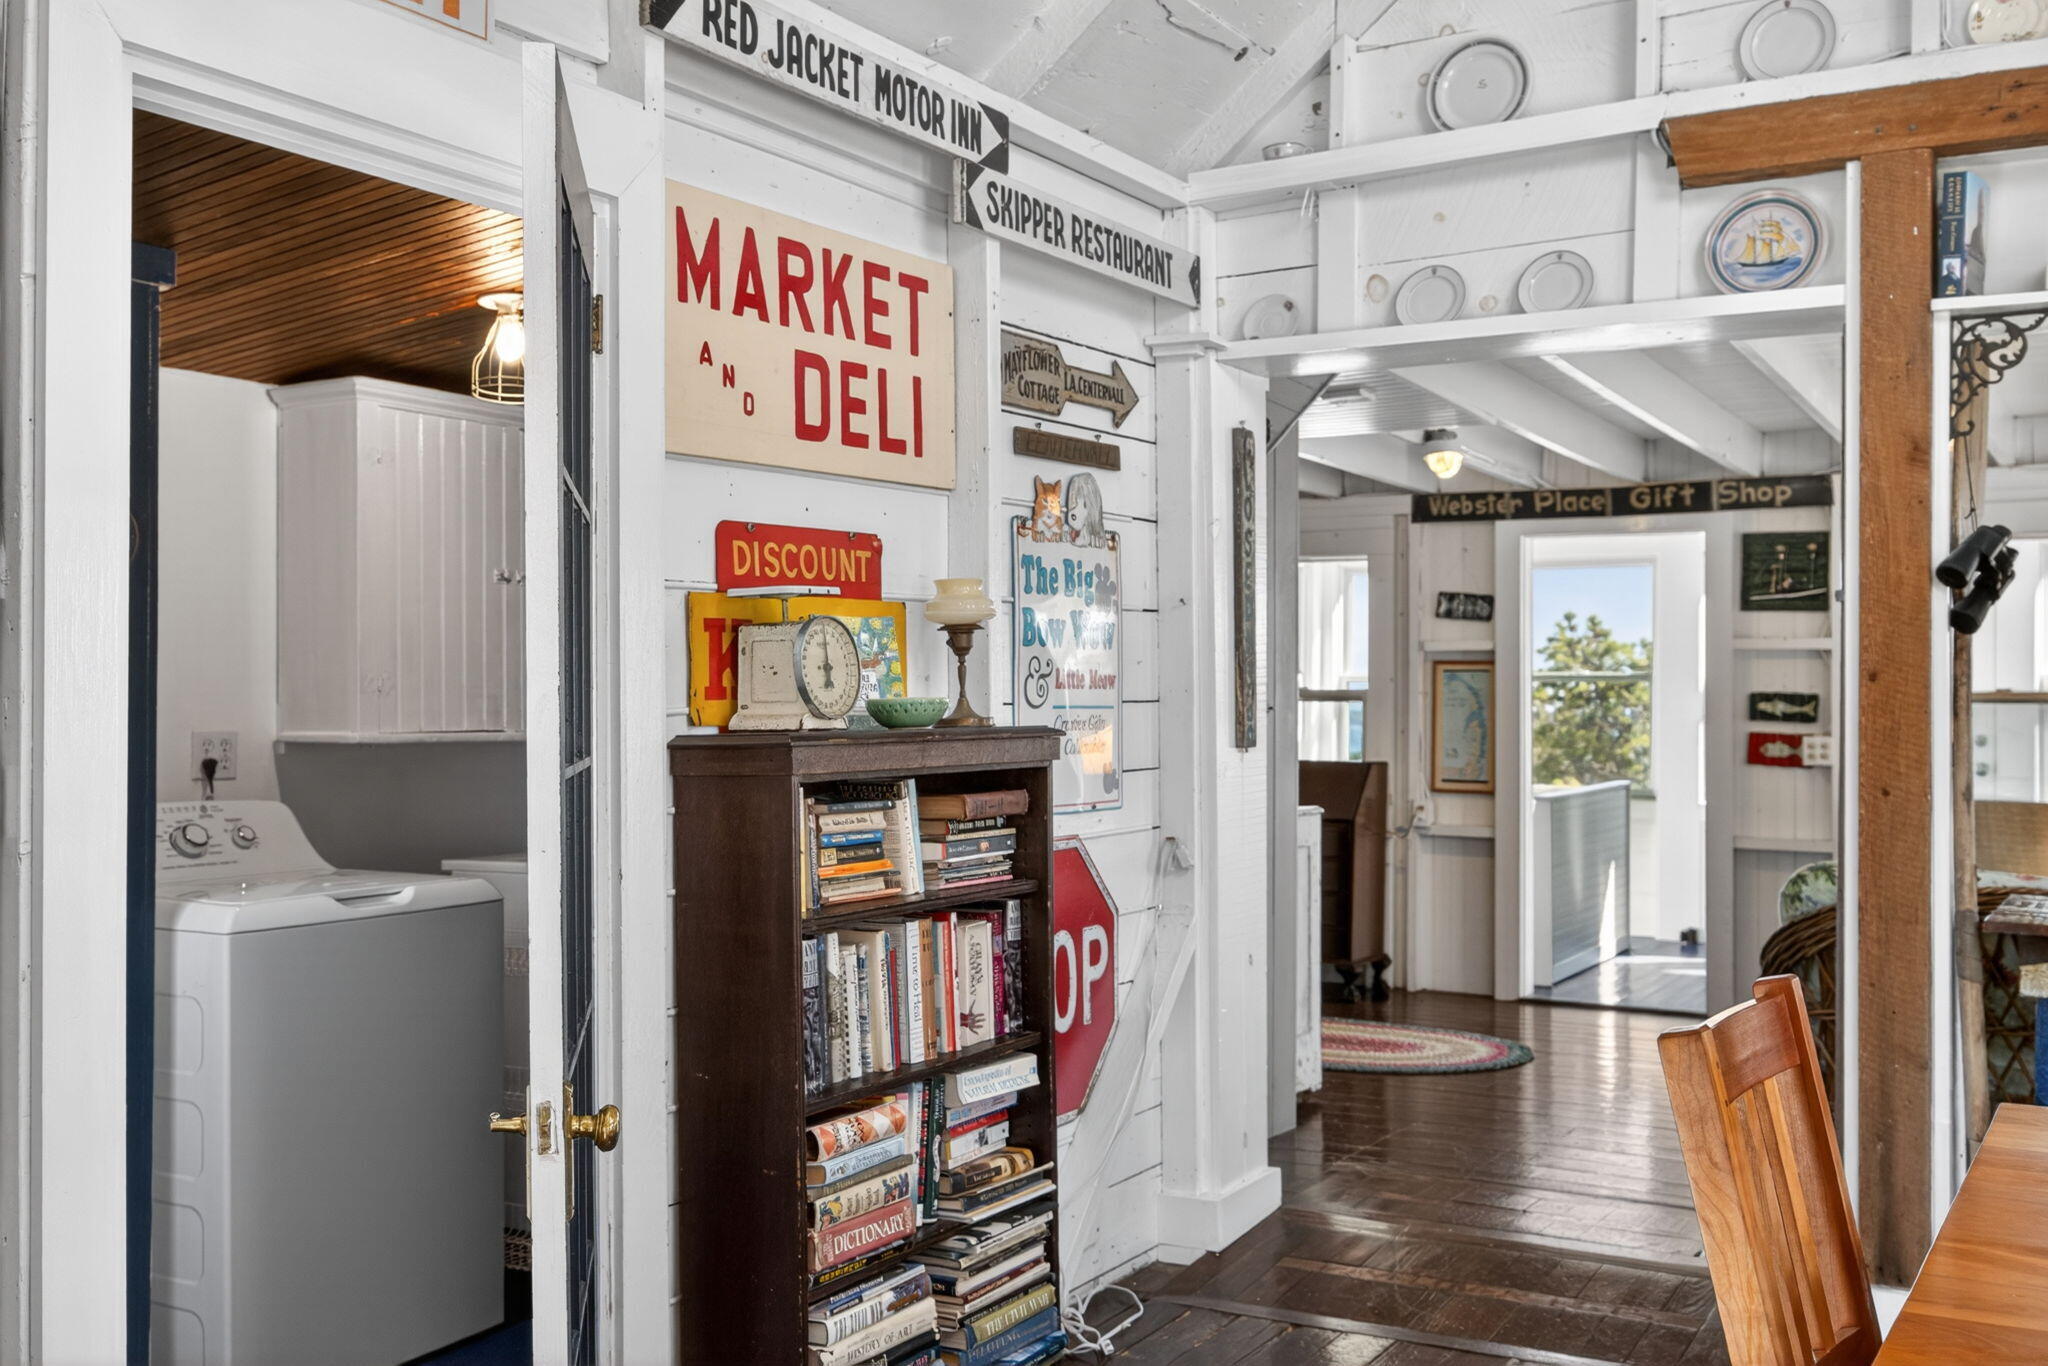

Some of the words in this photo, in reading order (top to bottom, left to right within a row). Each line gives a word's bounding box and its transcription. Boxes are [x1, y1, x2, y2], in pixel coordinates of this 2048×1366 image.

[702, 0, 758, 55] RED
[768, 19, 863, 102] JACKET
[875, 64, 945, 140] MOTOR
[951, 98, 981, 155] INN
[986, 181, 1066, 249] SKIPPER
[1071, 213, 1173, 289] RESTAURANT
[676, 206, 929, 357] MARKET
[699, 340, 755, 416] AND
[1004, 348, 1061, 384] MAYFLOWER
[1017, 374, 1060, 405] COTTAGE
[795, 349, 923, 458] DELI
[1428, 494, 1523, 516] Webster
[1534, 491, 1605, 513] Place
[1629, 484, 1695, 509] Gift
[1718, 481, 1792, 507] Shop
[732, 539, 872, 583] DISCOUNT
[1021, 554, 1059, 596] The
[1063, 558, 1095, 607] Big
[1024, 656, 1054, 710] &
[834, 1212, 905, 1255] DICTIONARY
[898, 1324, 914, 1341] ART
